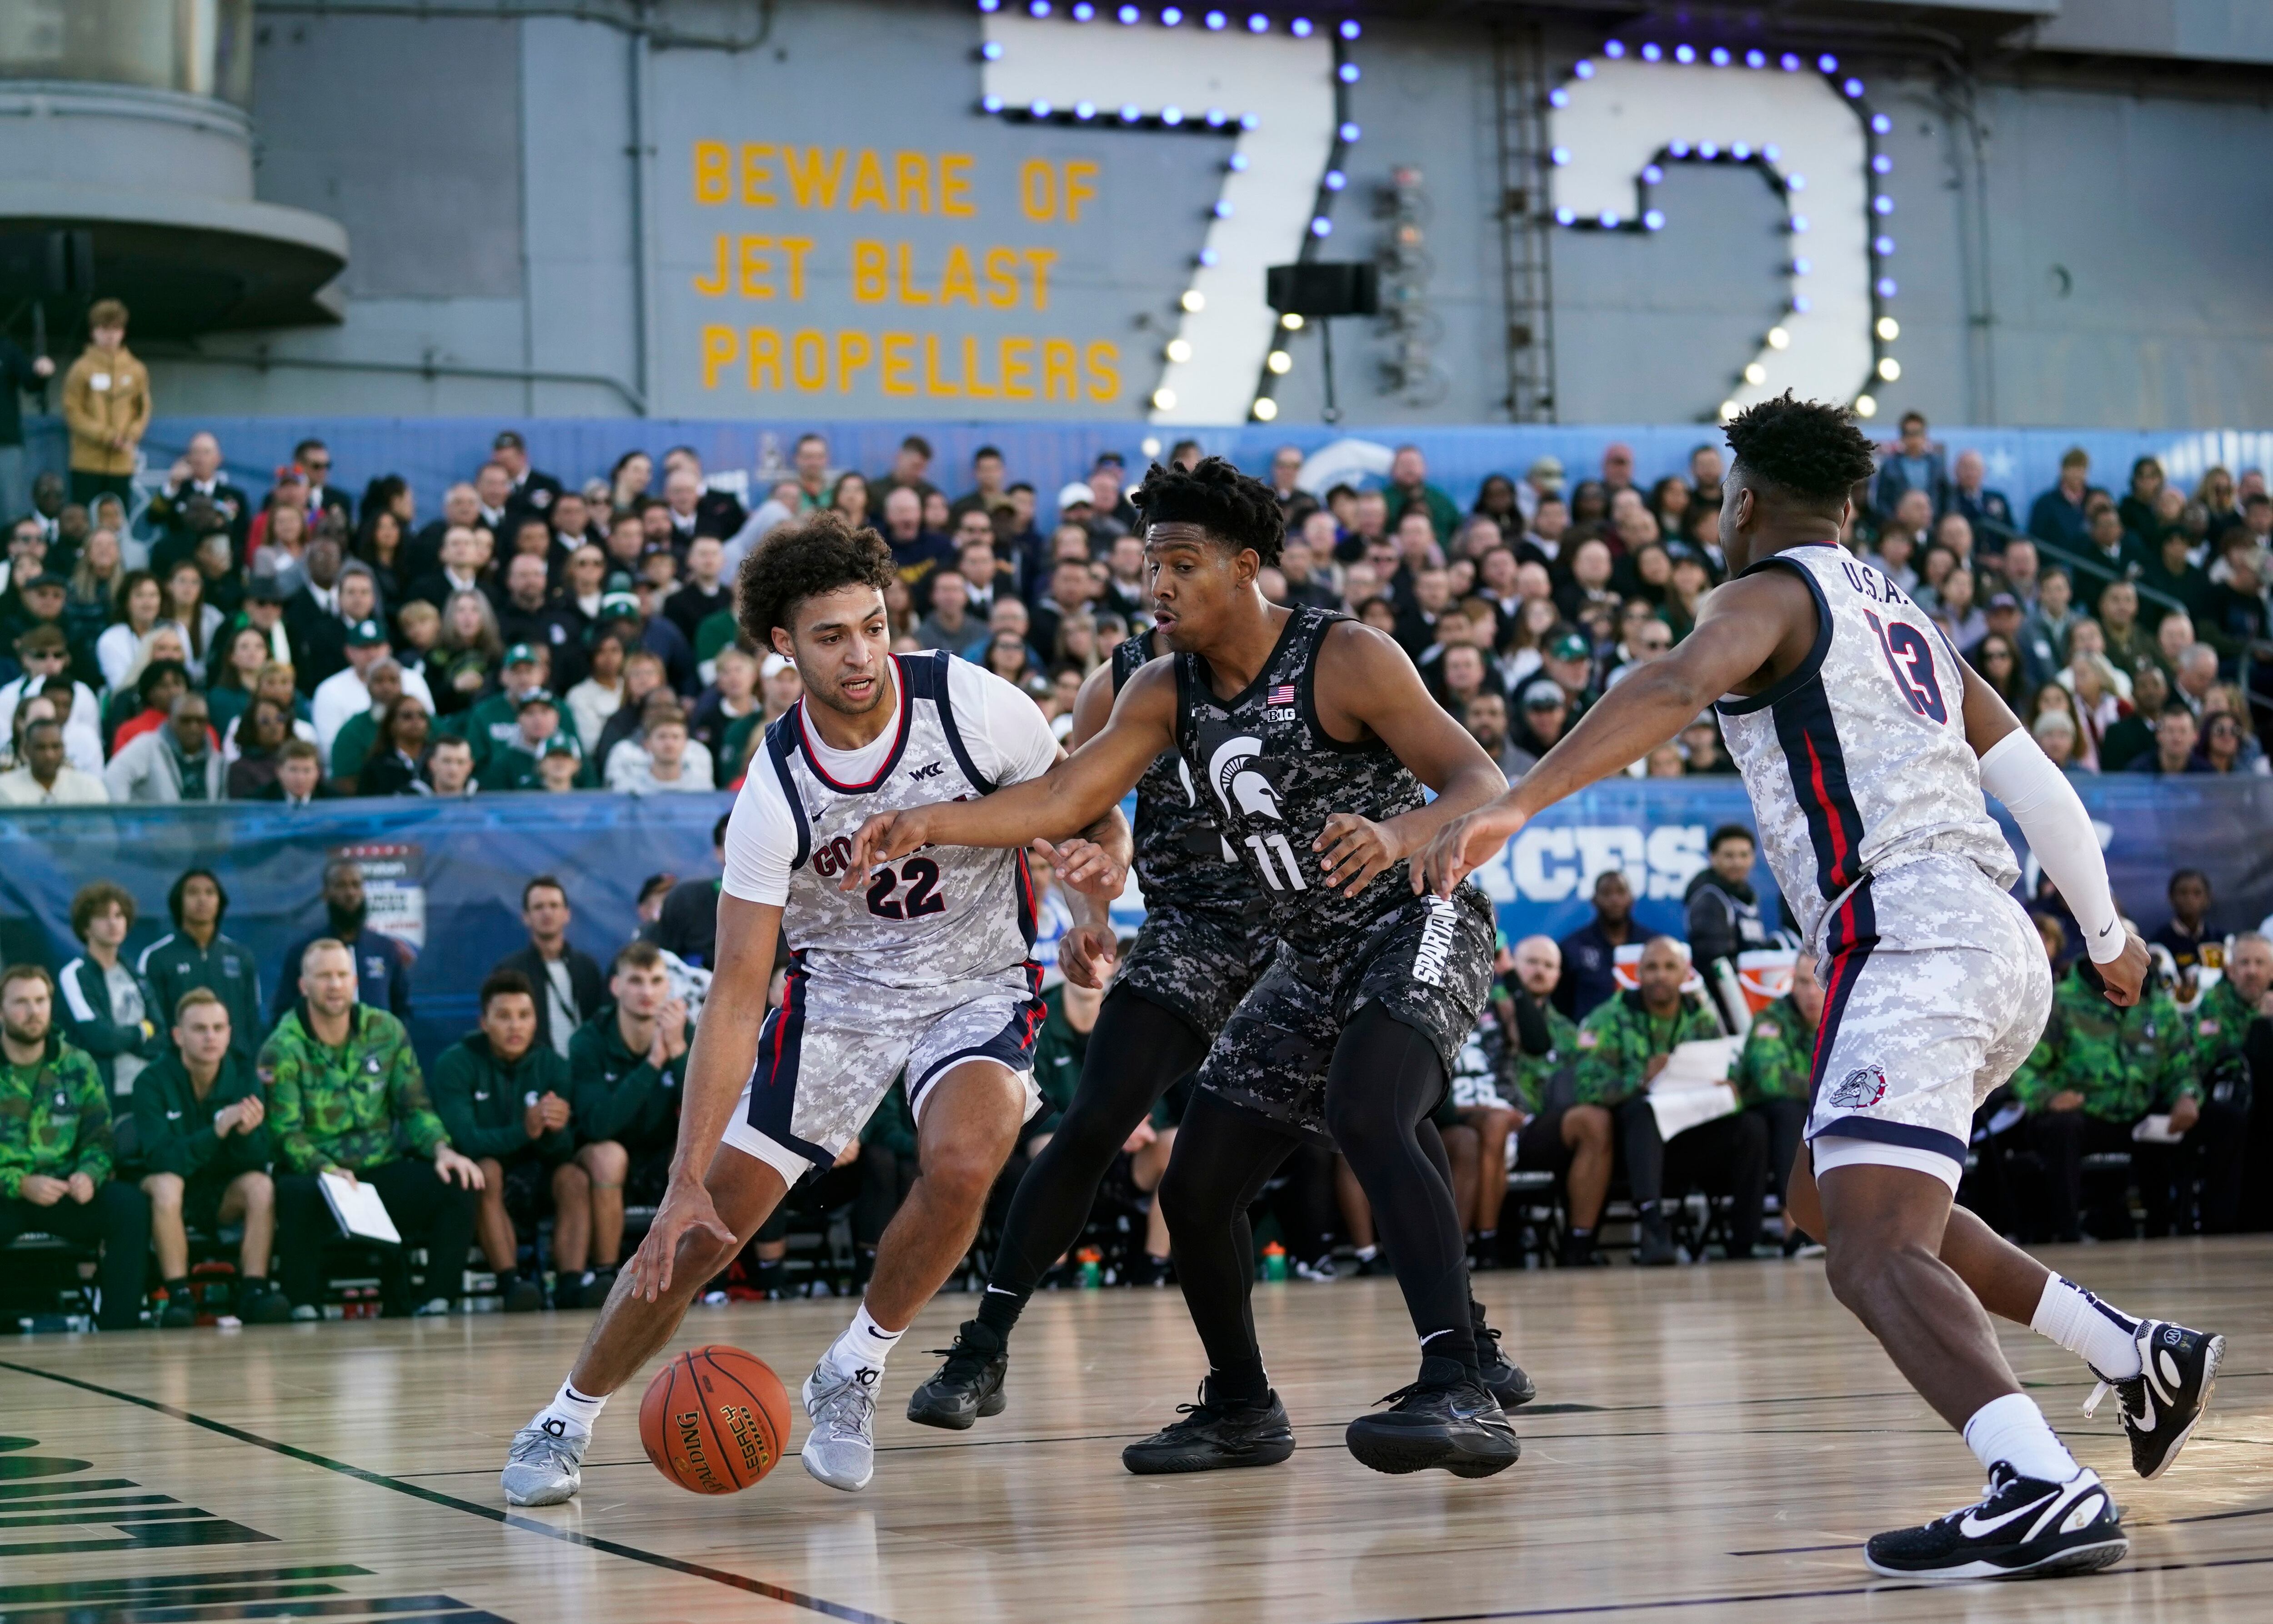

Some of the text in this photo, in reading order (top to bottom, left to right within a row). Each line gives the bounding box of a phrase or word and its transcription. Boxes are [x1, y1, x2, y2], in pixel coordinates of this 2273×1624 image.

[696, 141, 1096, 220] BEWARE OF
[696, 236, 1056, 308] JET BLAST
[704, 326, 1119, 401] PROPELLERS
[1842, 562, 1909, 605] U.S.A.
[1862, 607, 1948, 725] 13
[908, 761, 944, 782] WCC
[866, 857, 946, 920] 22
[1244, 834, 1308, 891] 11
[1412, 894, 1458, 987] SPARTAN
[1452, 1074, 1497, 1107] 25
[720, 1404, 761, 1479] LEGACY
[739, 1406, 766, 1452] 1000
